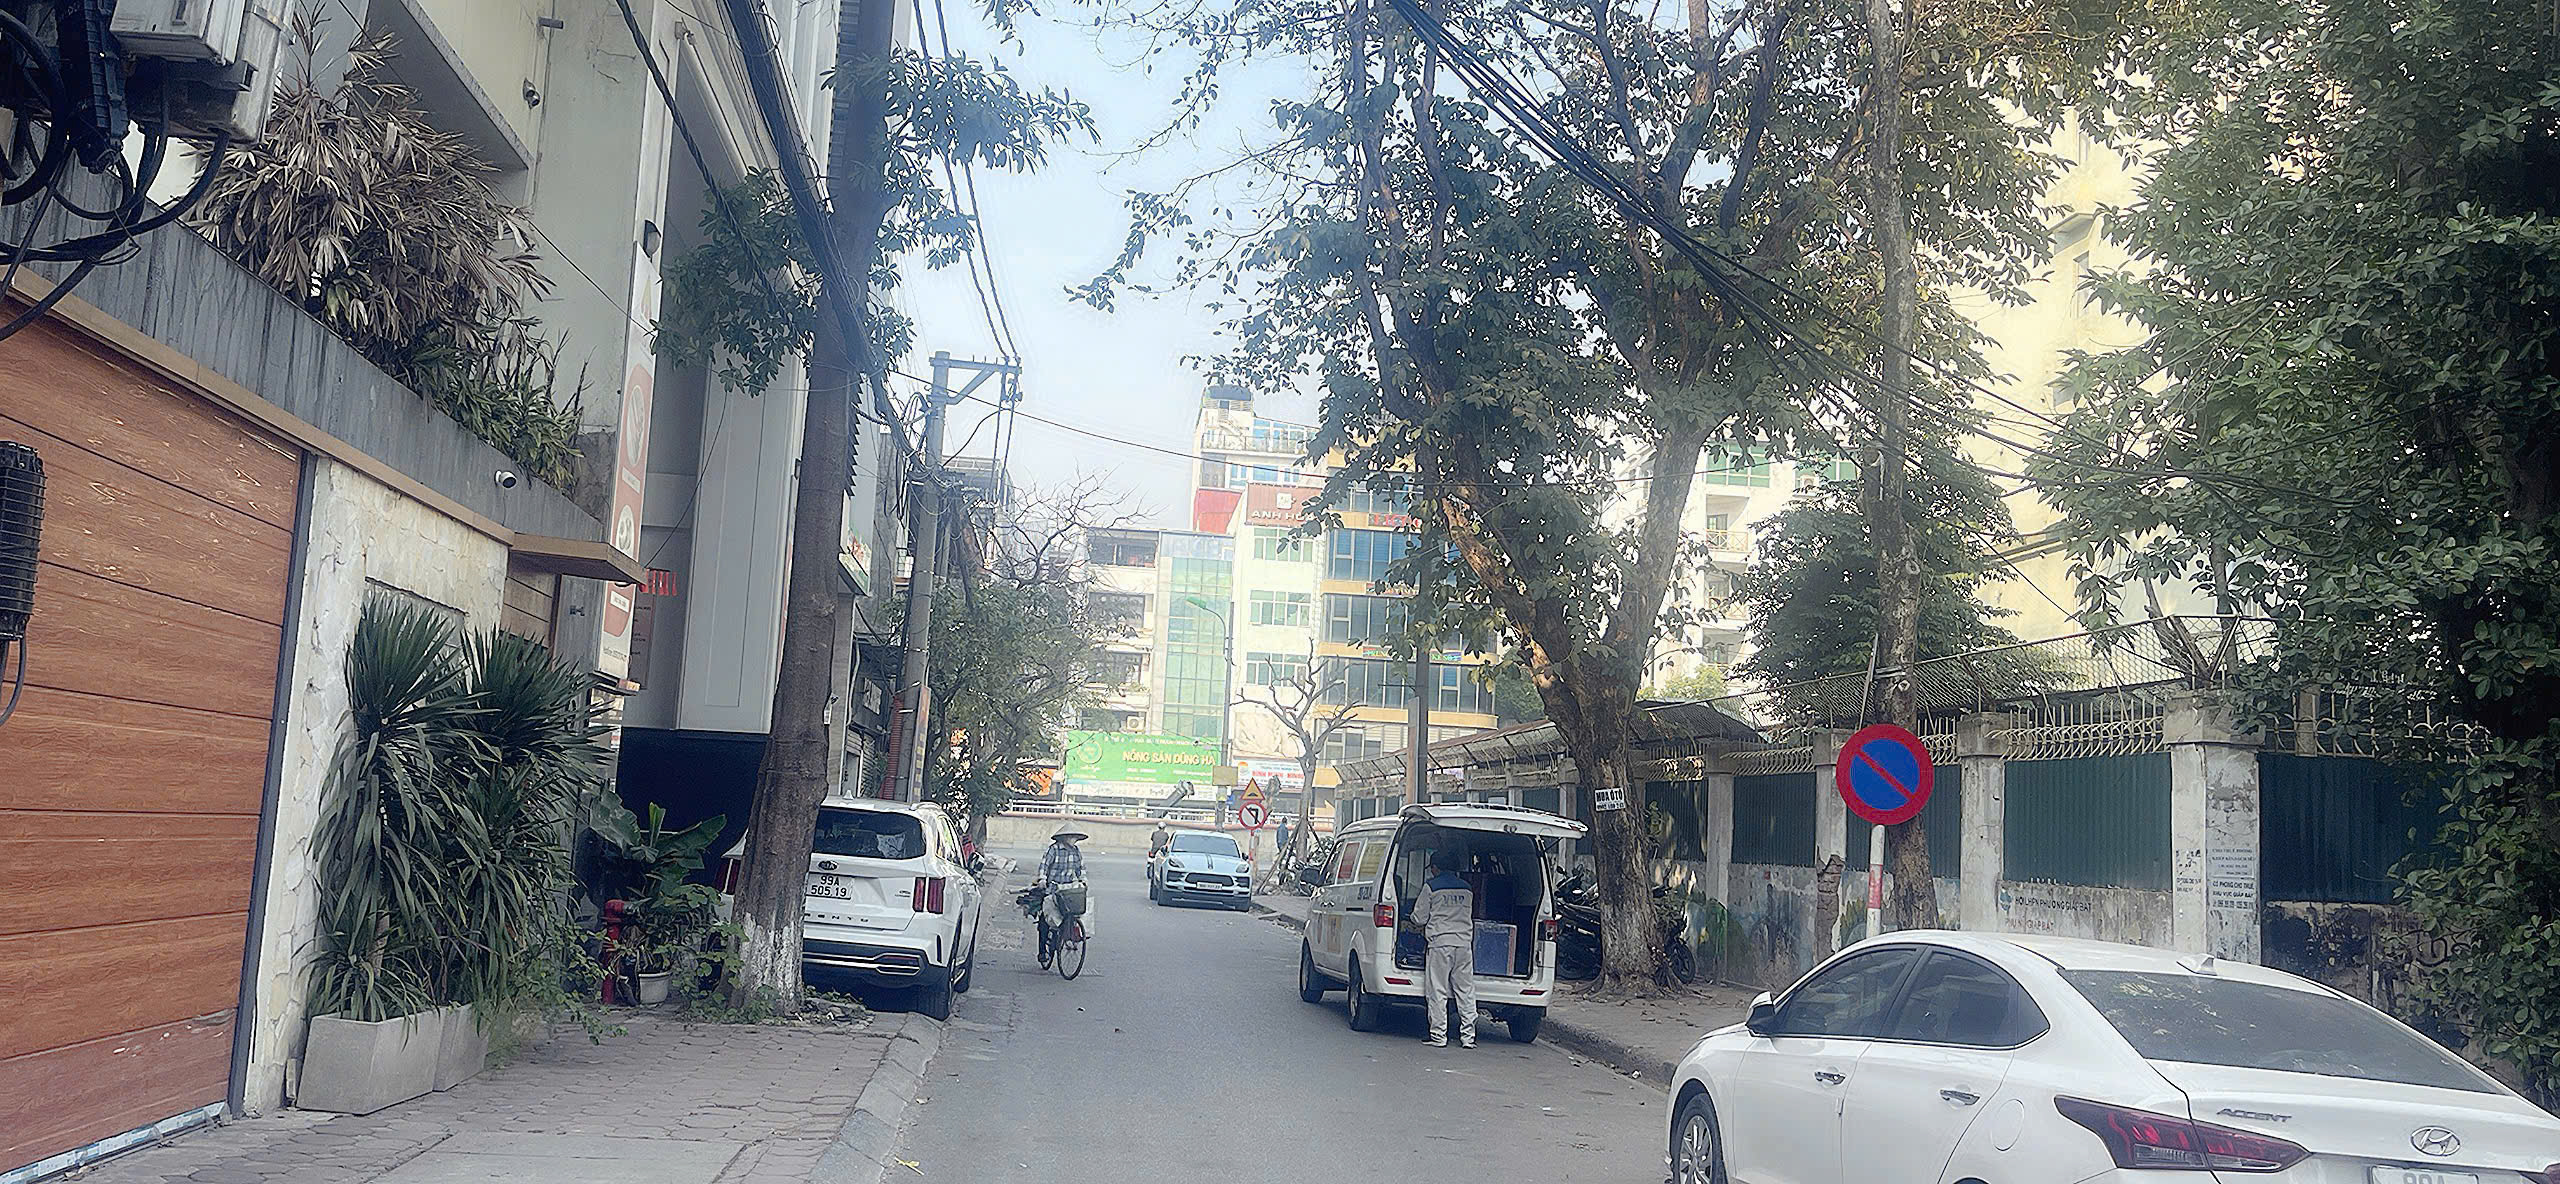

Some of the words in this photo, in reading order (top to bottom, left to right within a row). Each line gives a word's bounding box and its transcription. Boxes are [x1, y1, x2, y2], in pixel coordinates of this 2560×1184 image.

[1251, 510, 1281, 520] ANH
[820, 875, 840, 886] 99A
[811, 884, 847, 897] 505.19
[2216, 1108, 2292, 1122] ACCENT
